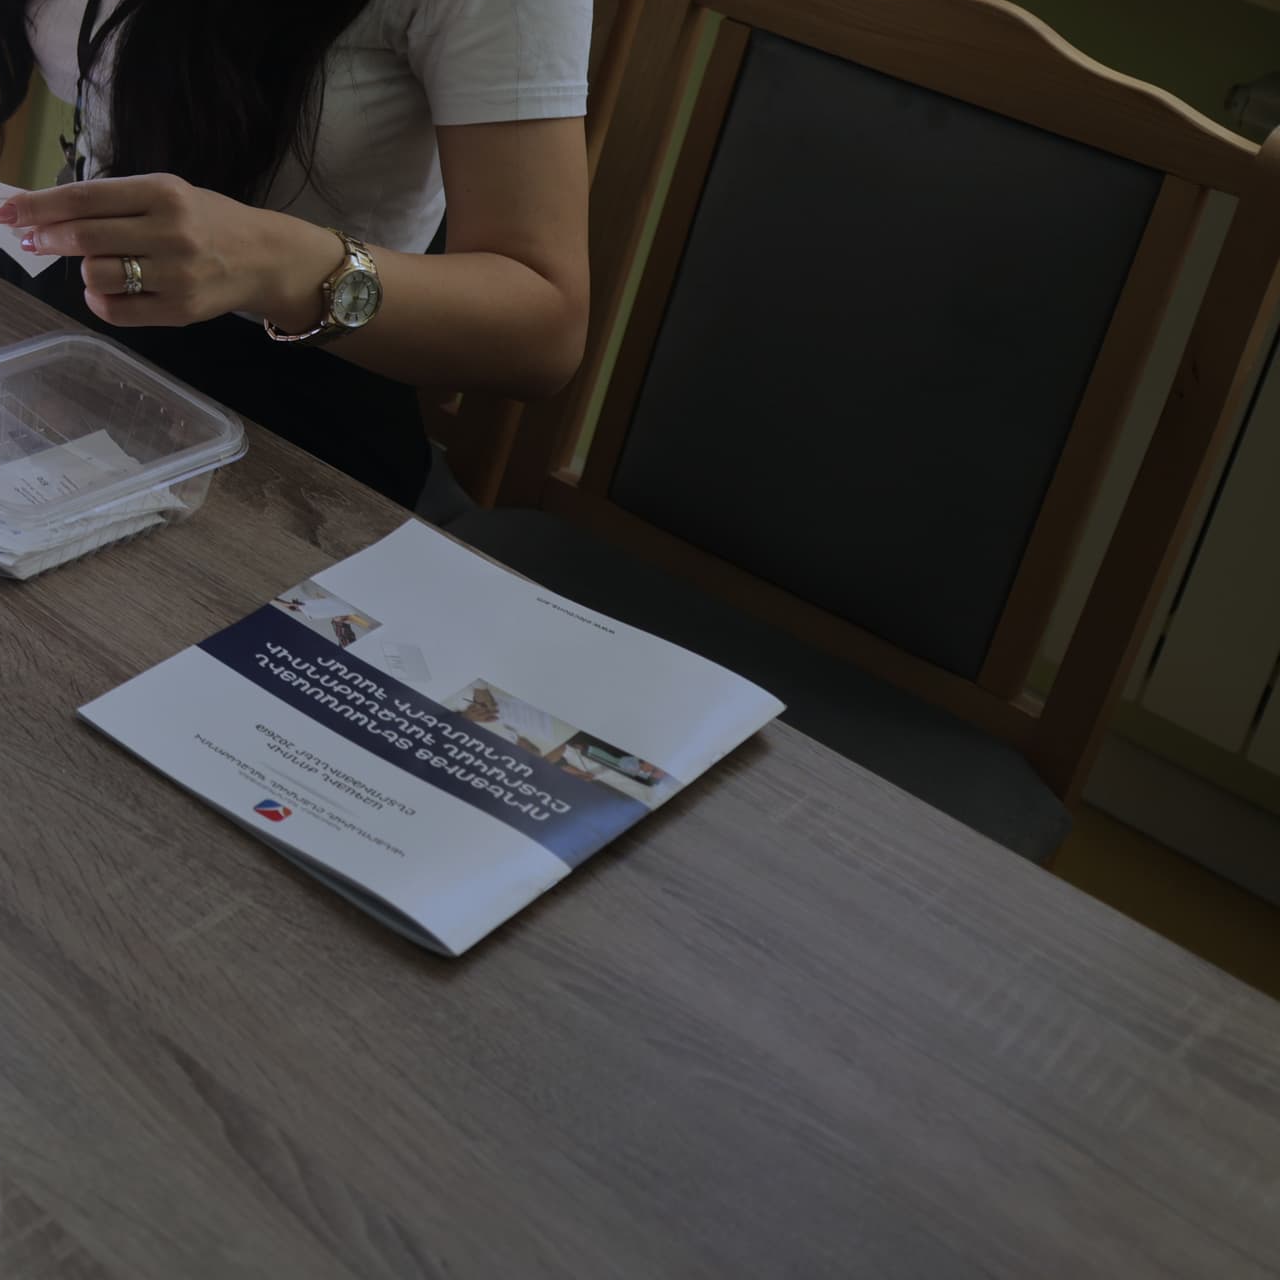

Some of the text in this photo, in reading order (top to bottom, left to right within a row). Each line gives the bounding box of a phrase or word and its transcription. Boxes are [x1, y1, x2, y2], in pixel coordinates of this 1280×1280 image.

[255, 653, 414, 750] ՏԵՂԱՄԱՍԱՅԻՆ
[266, 641, 436, 745] ՀԱՆՁՆԱԺՈՂՈՎԻ
[316, 656, 533, 777] ԱՆԴԱՄՆԵՐԻ ՀԱՄԱՐ
[414, 748, 551, 821] ՈՒՂԵՑՈՒՅՑ
[443, 743, 572, 814] ԸՆՏՐԱԿԱՆ
